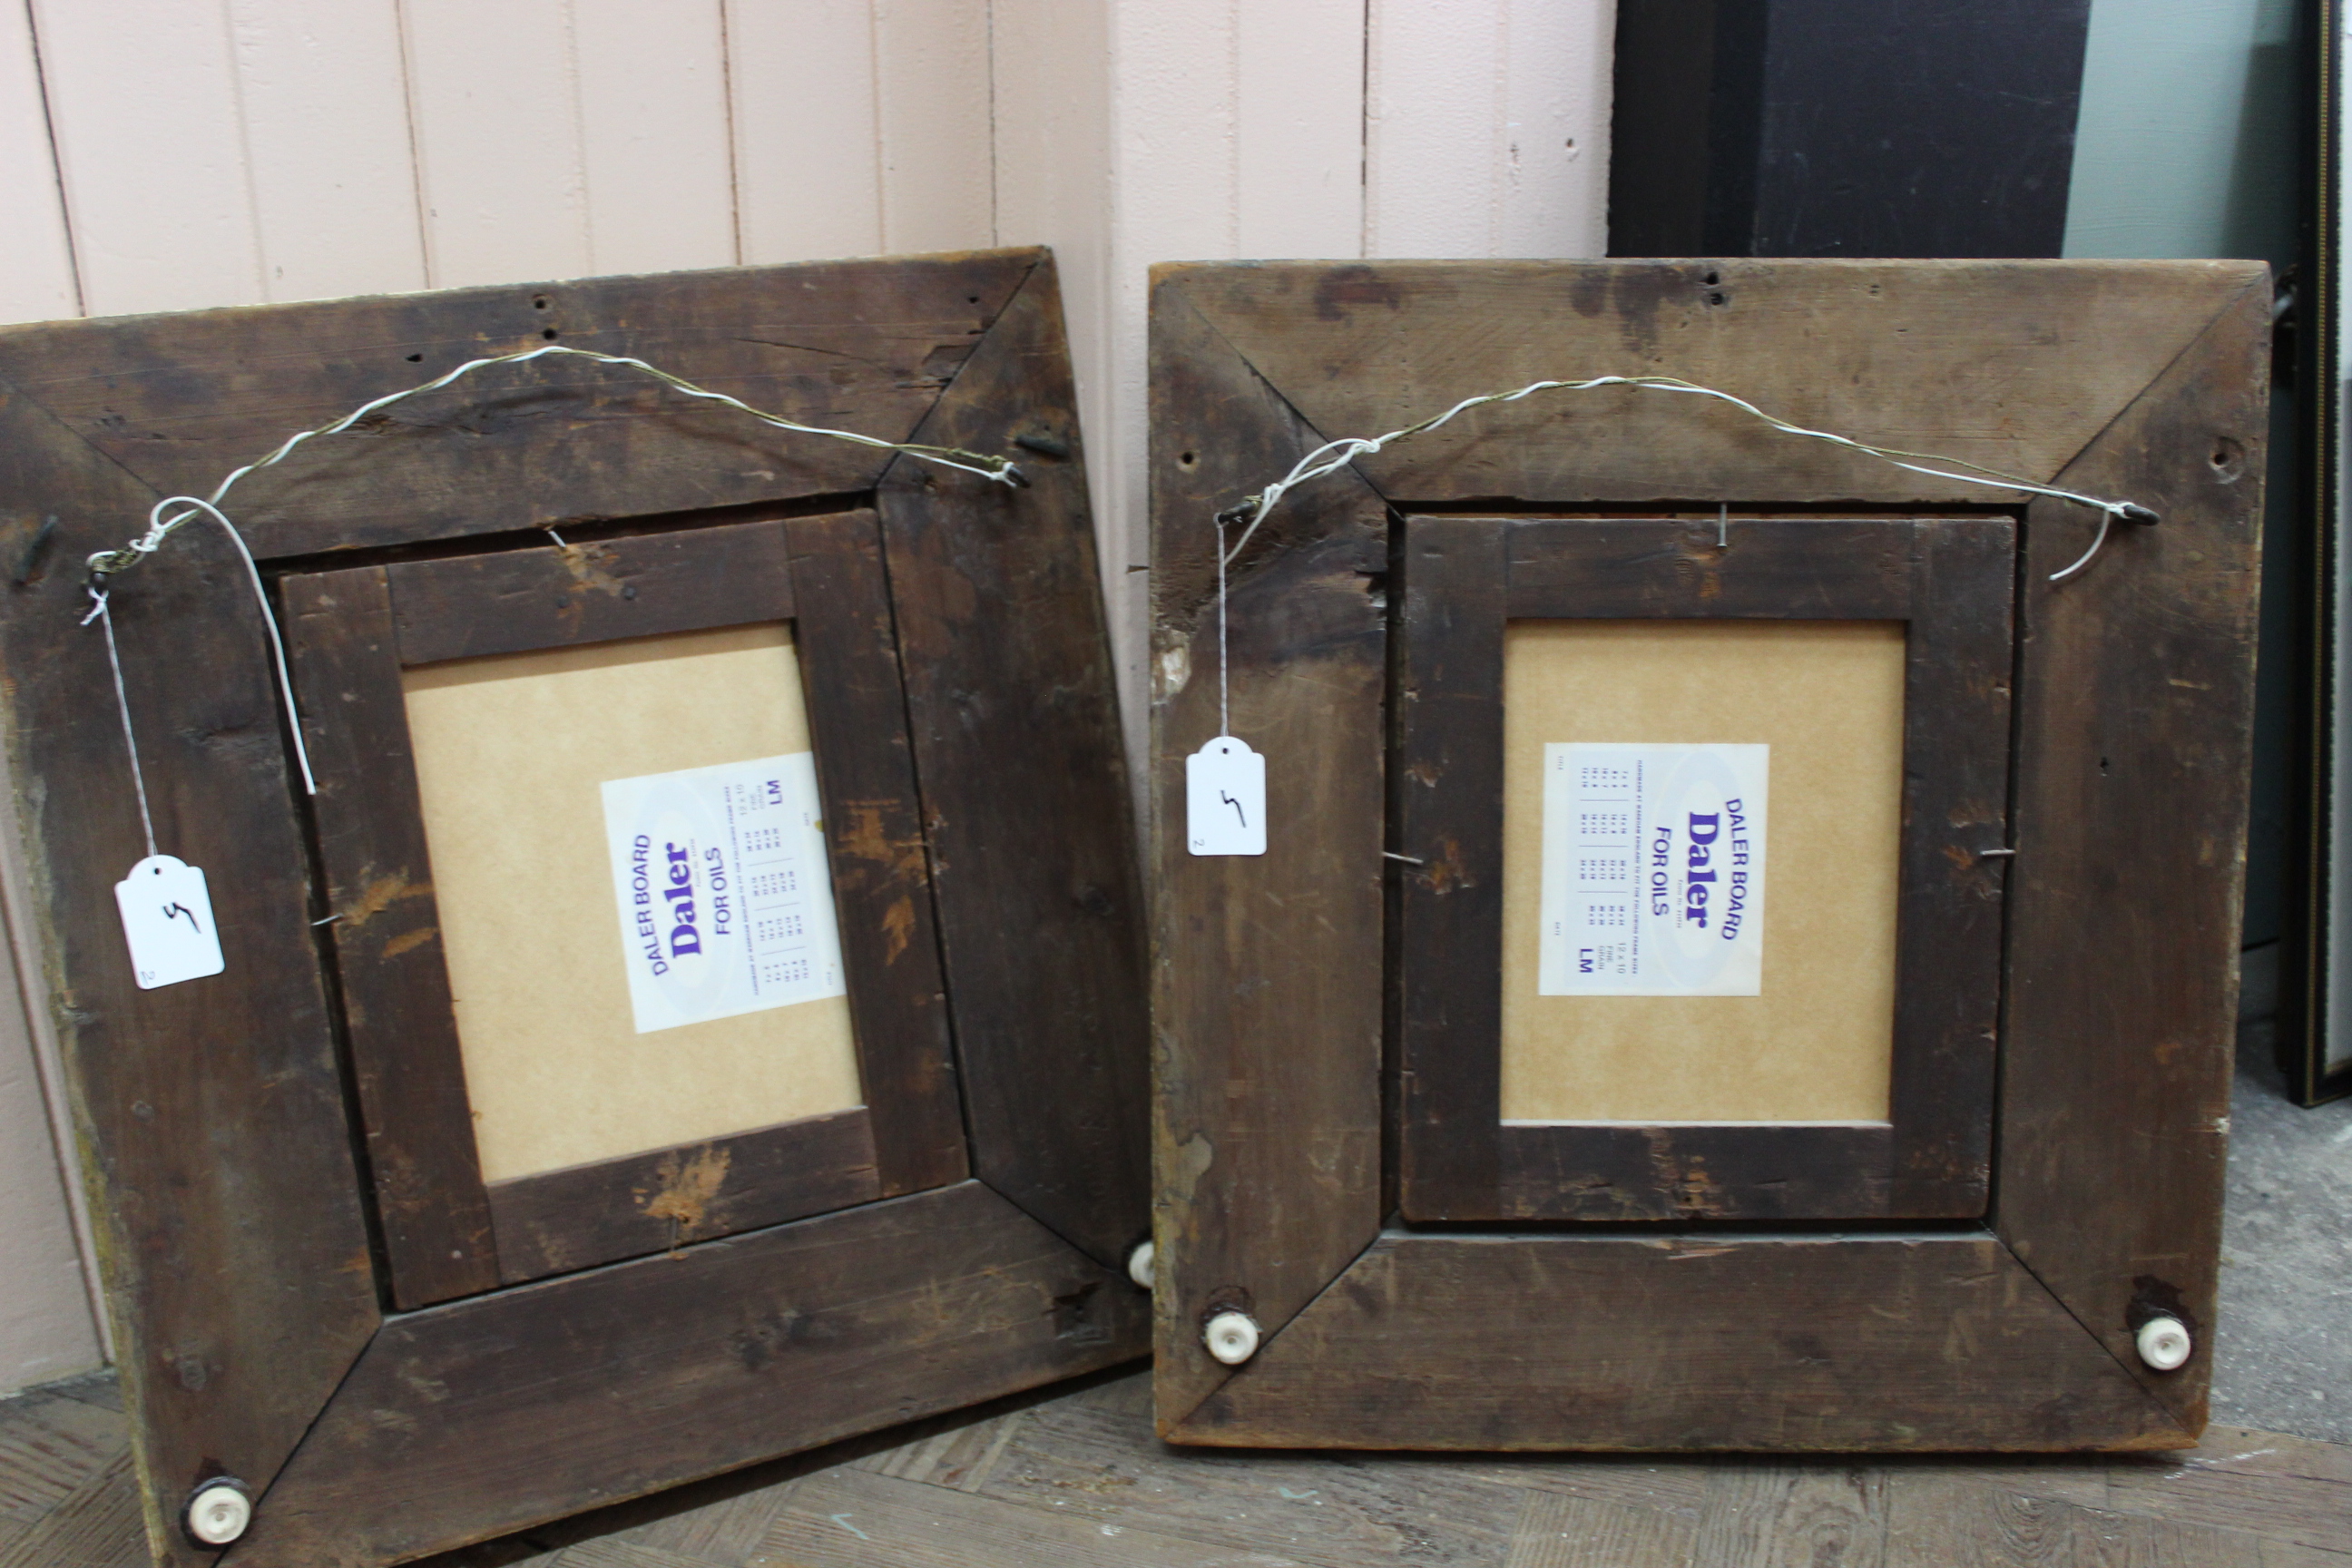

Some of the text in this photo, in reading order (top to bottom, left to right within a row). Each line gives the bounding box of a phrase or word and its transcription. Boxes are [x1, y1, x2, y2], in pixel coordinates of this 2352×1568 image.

[767, 780, 781, 805] LM
[633, 835, 668, 975] DALER BOARD
[664, 843, 701, 958] Daler
[706, 848, 730, 935] FOR OILS
[1652, 828, 1671, 916] FOR OILS
[1686, 812, 1719, 928] Daler
[1722, 799, 1748, 940] DALER BOARD
[1580, 949, 1592, 973] LM
